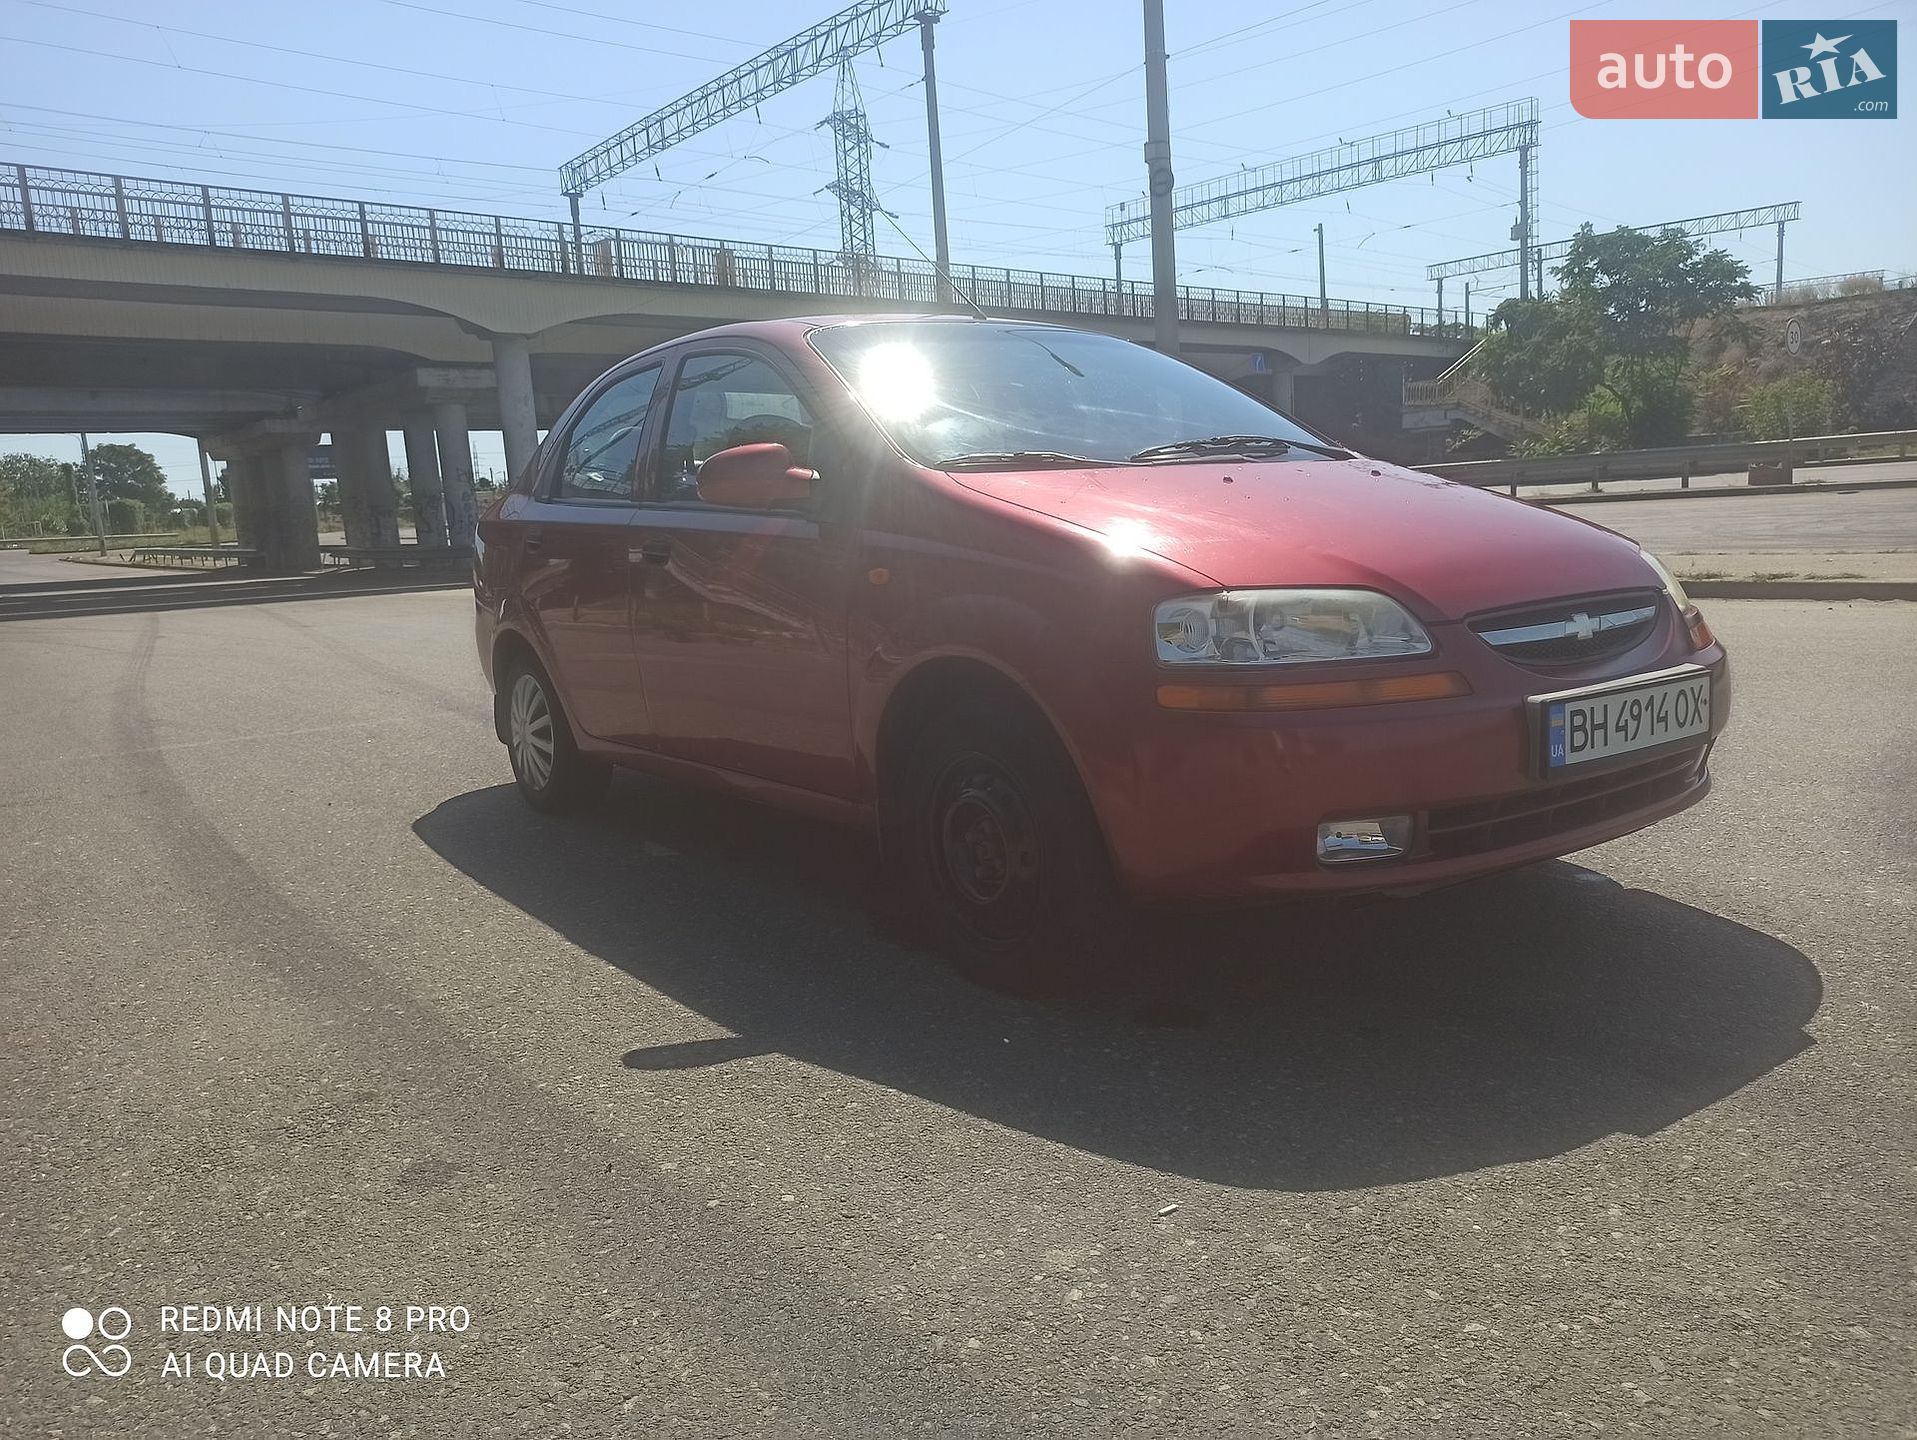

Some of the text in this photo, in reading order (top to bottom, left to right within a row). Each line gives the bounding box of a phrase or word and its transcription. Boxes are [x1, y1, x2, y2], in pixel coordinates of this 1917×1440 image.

[1790, 331, 1799, 344] 30
[1569, 684, 1704, 754] BH 4914 OX
[1551, 744, 1565, 757] UA
